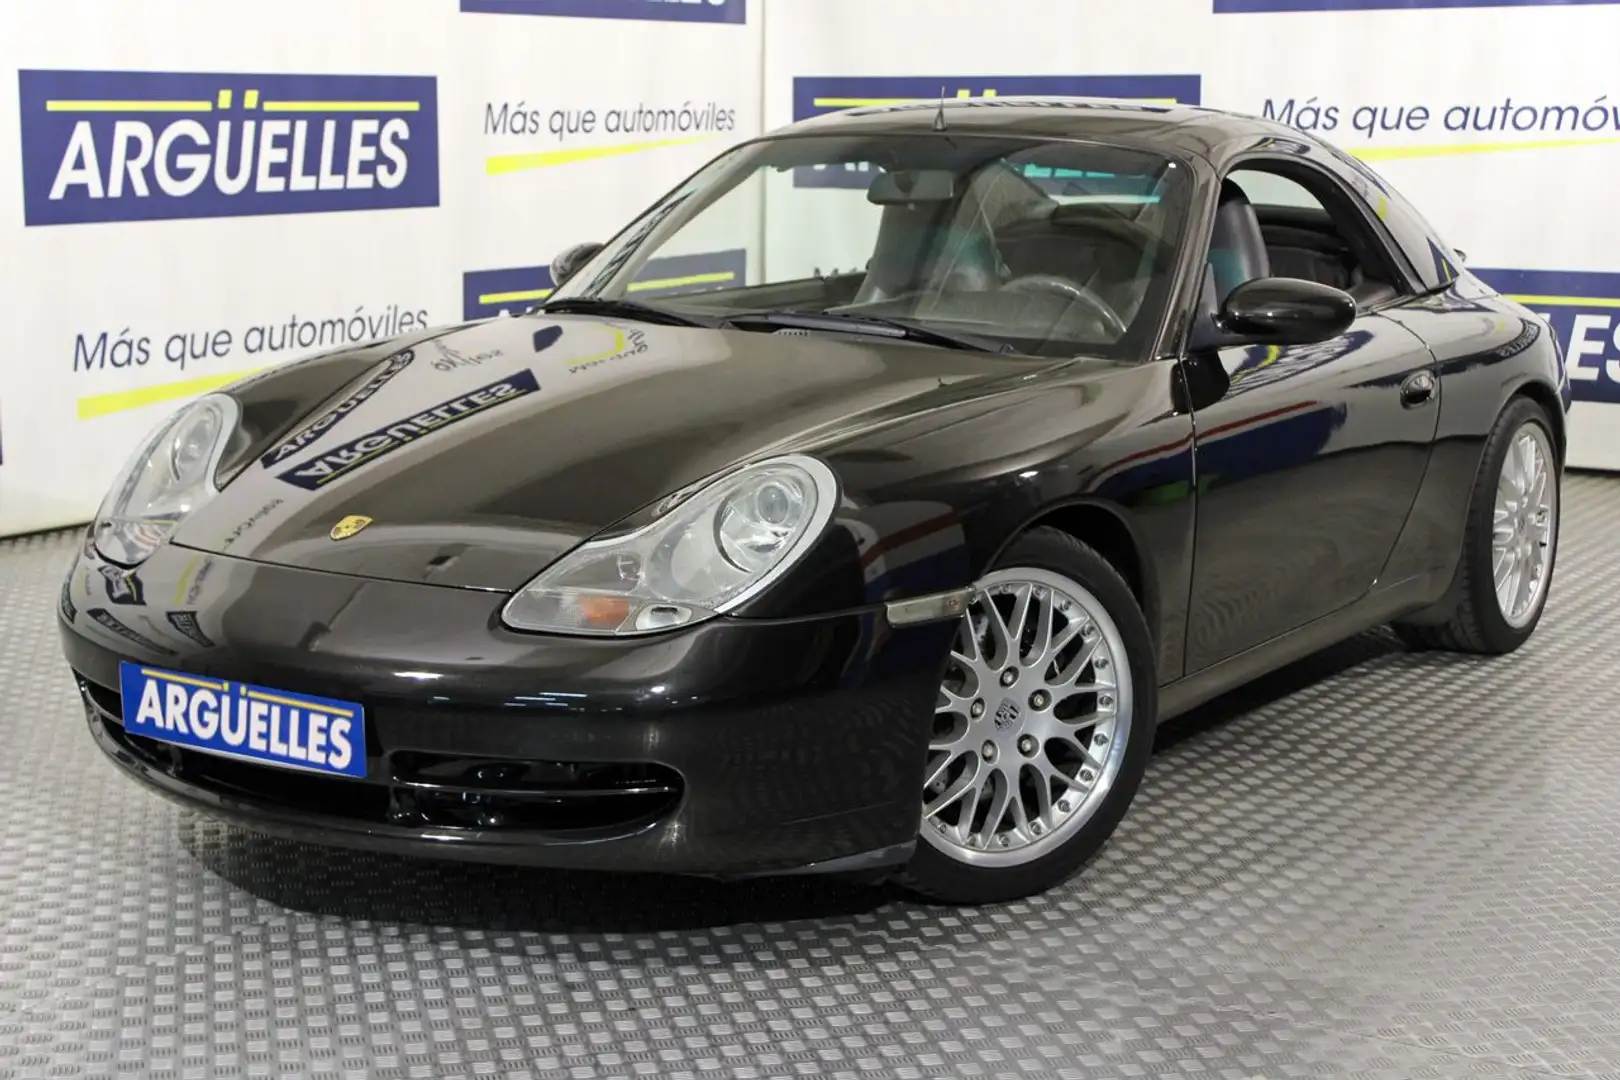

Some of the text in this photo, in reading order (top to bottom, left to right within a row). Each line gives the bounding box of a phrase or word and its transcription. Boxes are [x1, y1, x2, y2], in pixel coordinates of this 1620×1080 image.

[48, 89, 411, 200] ARGÜELLES
[484, 101, 736, 142] Más que automóviles
[1262, 96, 1339, 131] Más
[1352, 104, 1430, 138] que
[73, 327, 151, 372] Más
[164, 329, 233, 371] que
[243, 304, 429, 354] automóviles
[136, 681, 352, 770] ARGÜELLES
